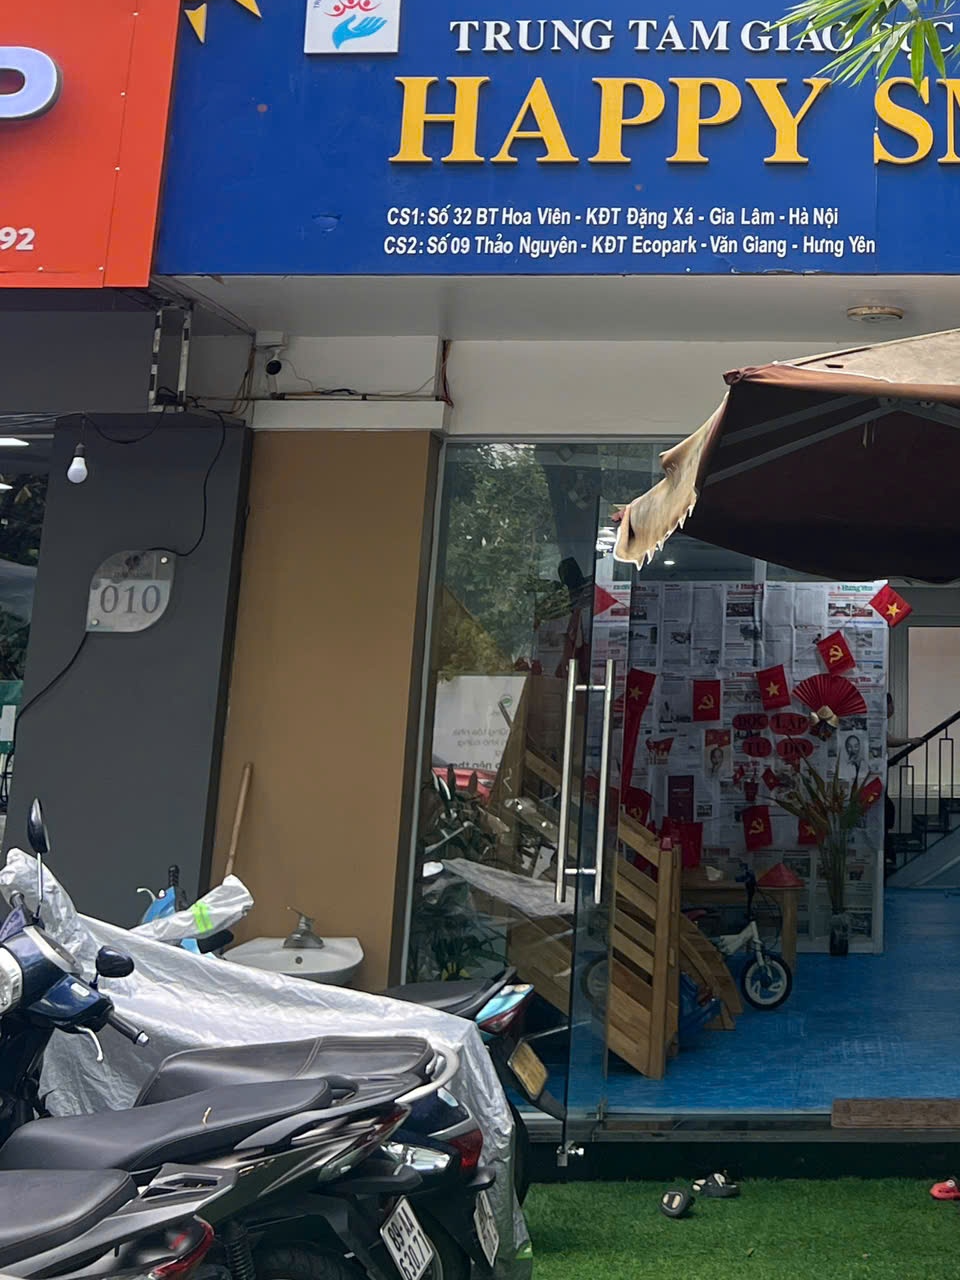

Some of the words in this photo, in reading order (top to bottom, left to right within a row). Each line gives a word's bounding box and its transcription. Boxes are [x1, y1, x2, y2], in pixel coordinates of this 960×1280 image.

[449, 19, 615, 52] TRUNG
[628, 14, 730, 52] TÂM
[388, 76, 832, 163] HAPPY
[428, 204, 451, 225] Số
[453, 207, 472, 225] 32
[476, 207, 499, 225] BT
[502, 207, 532, 225] Hoa
[537, 207, 571, 225] Viên
[586, 207, 622, 225] KĐT
[627, 207, 667, 229] Đặng
[672, 207, 694, 225] Xá
[709, 207, 735, 225] Gia
[741, 207, 775, 225] Lâm
[789, 207, 809, 225] Hà
[813, 207, 838, 229] Nội
[427, 233, 451, 254] Số
[451, 236, 470, 254] 09
[475, 233, 513, 254] Thảo
[519, 235, 577, 258] Nguyên
[592, 235, 628, 254] KĐT
[632, 235, 697, 258] Ecopark
[710, 235, 738, 253] Văn
[742, 235, 787, 258] Giang
[803, 235, 844, 258] Hưng
[849, 235, 876, 253] Yên
[101, 585, 160, 614] 010
